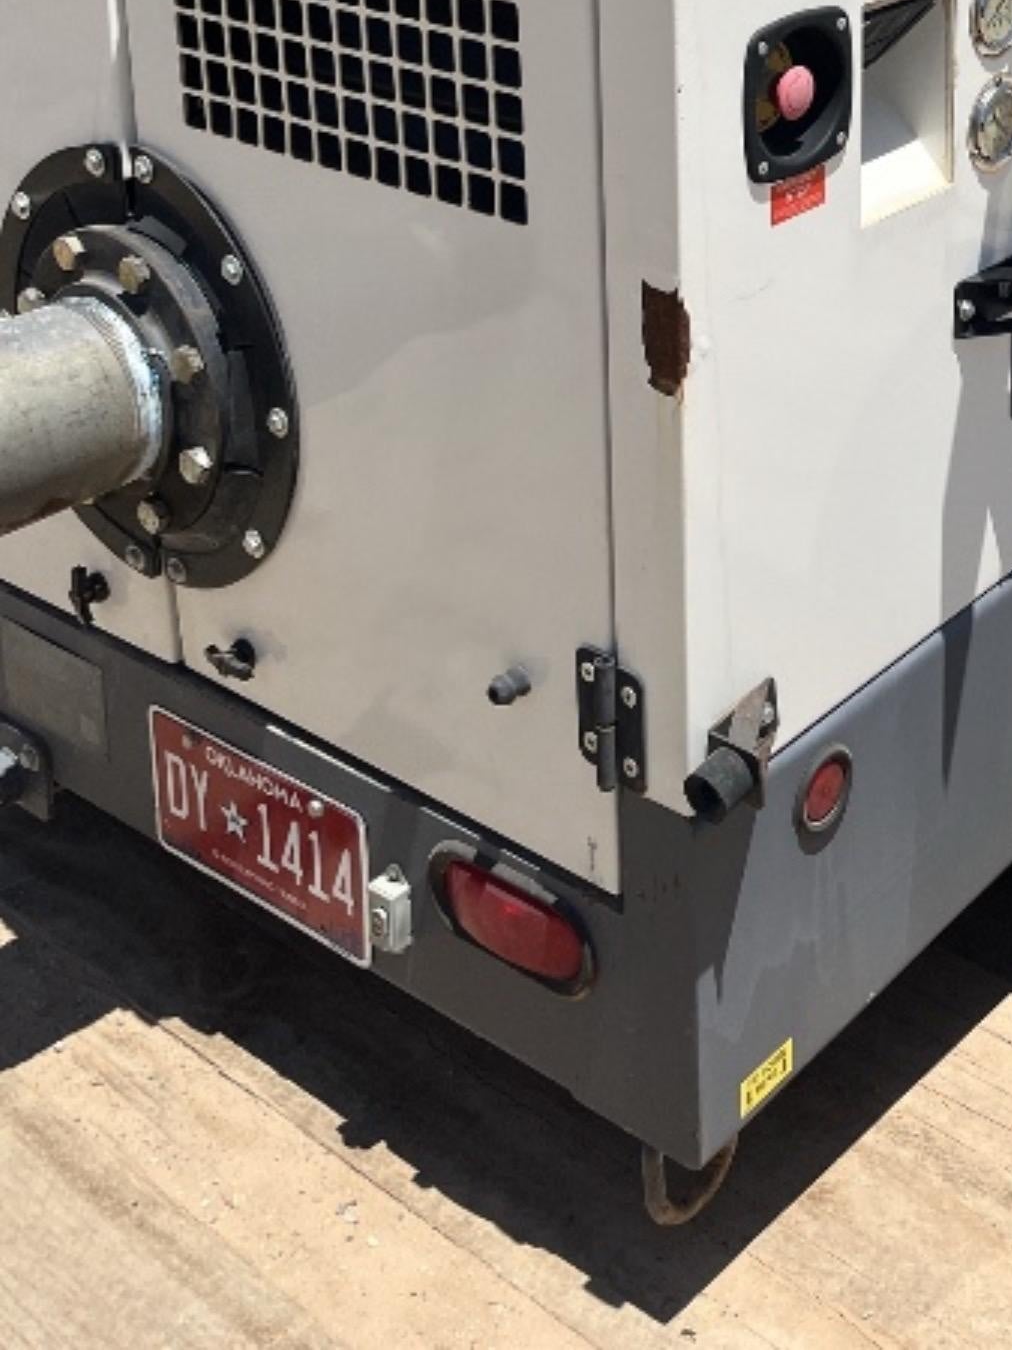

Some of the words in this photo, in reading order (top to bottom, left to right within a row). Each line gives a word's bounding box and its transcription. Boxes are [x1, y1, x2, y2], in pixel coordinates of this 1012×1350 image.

[165, 751, 208, 831] DY
[257, 803, 355, 916] 1414
[205, 746, 302, 813] OKLAHOMA
